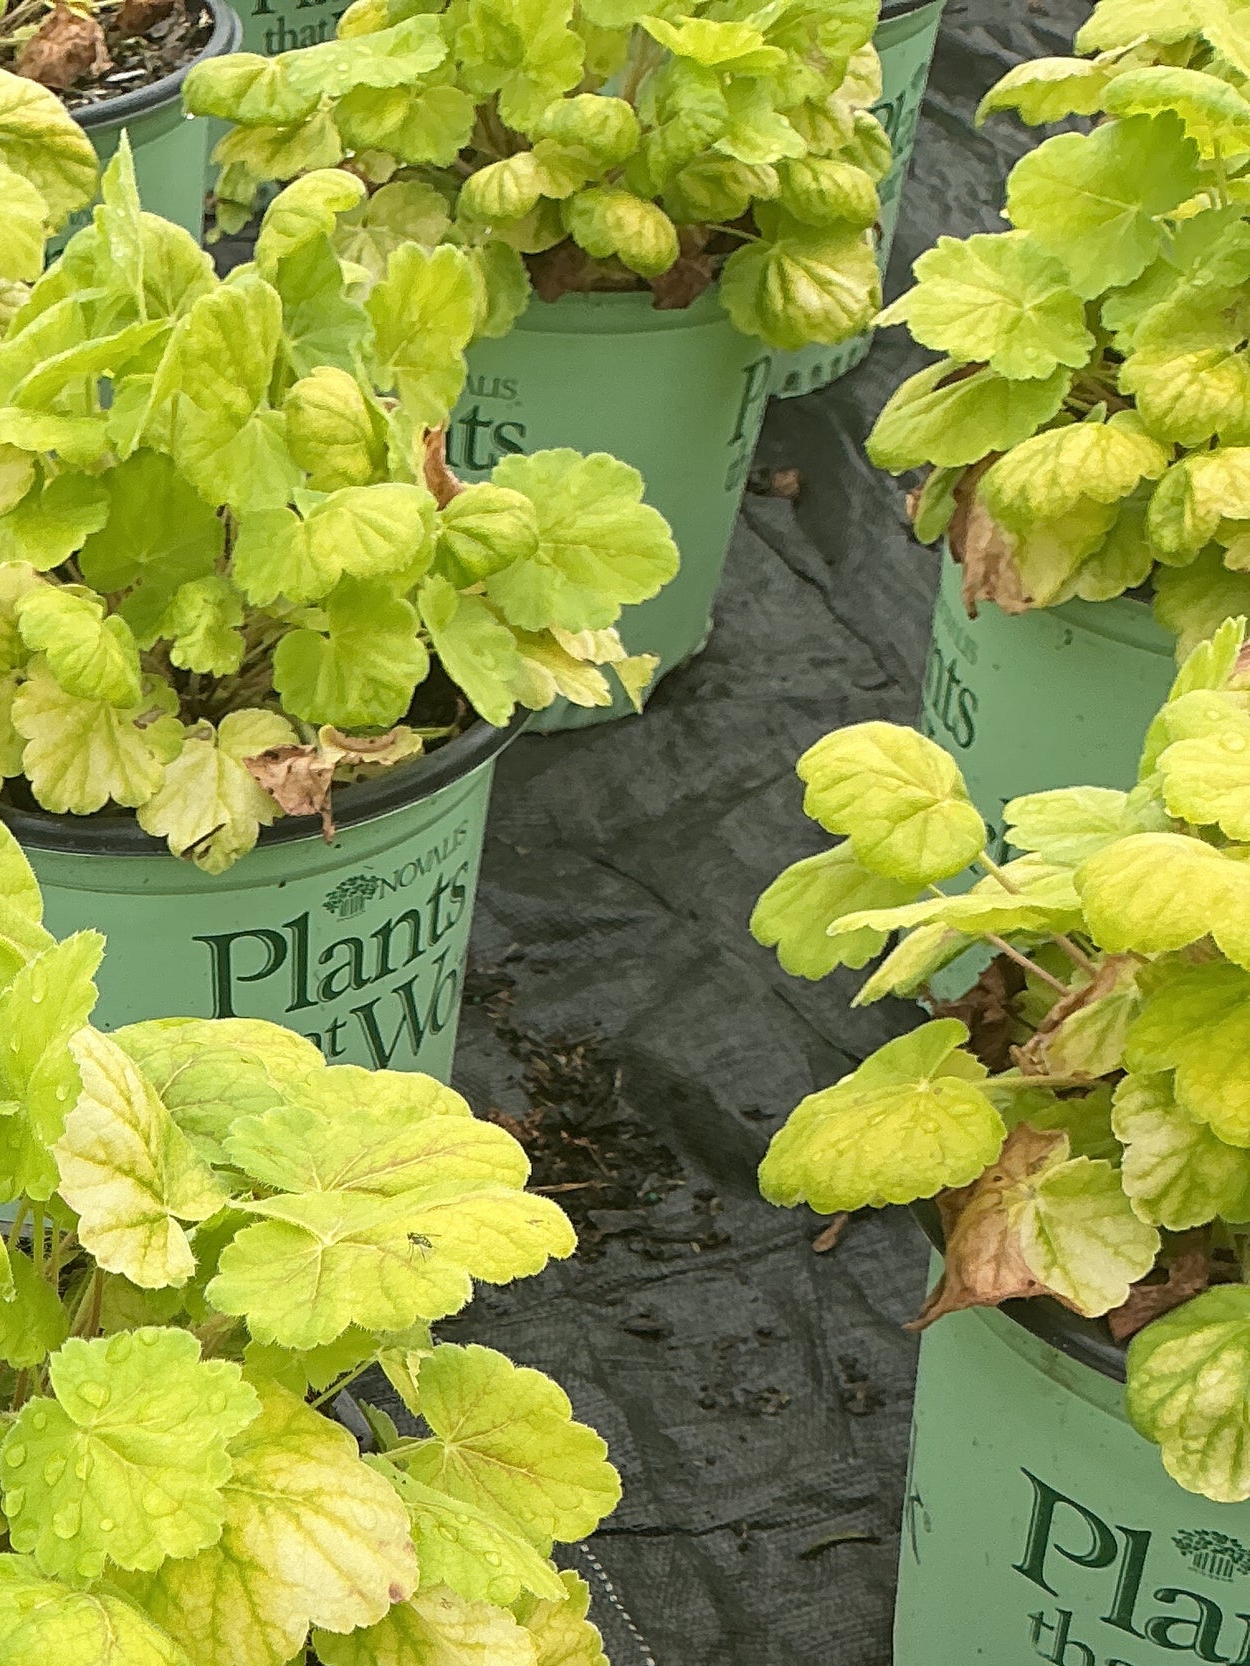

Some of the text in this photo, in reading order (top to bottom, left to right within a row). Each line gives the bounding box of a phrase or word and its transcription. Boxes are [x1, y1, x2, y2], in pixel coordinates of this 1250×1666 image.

[264, 15, 328, 54] that
[927, 647, 979, 749] nts
[379, 818, 469, 900] NOVALIS
[192, 860, 468, 1020] Plants
